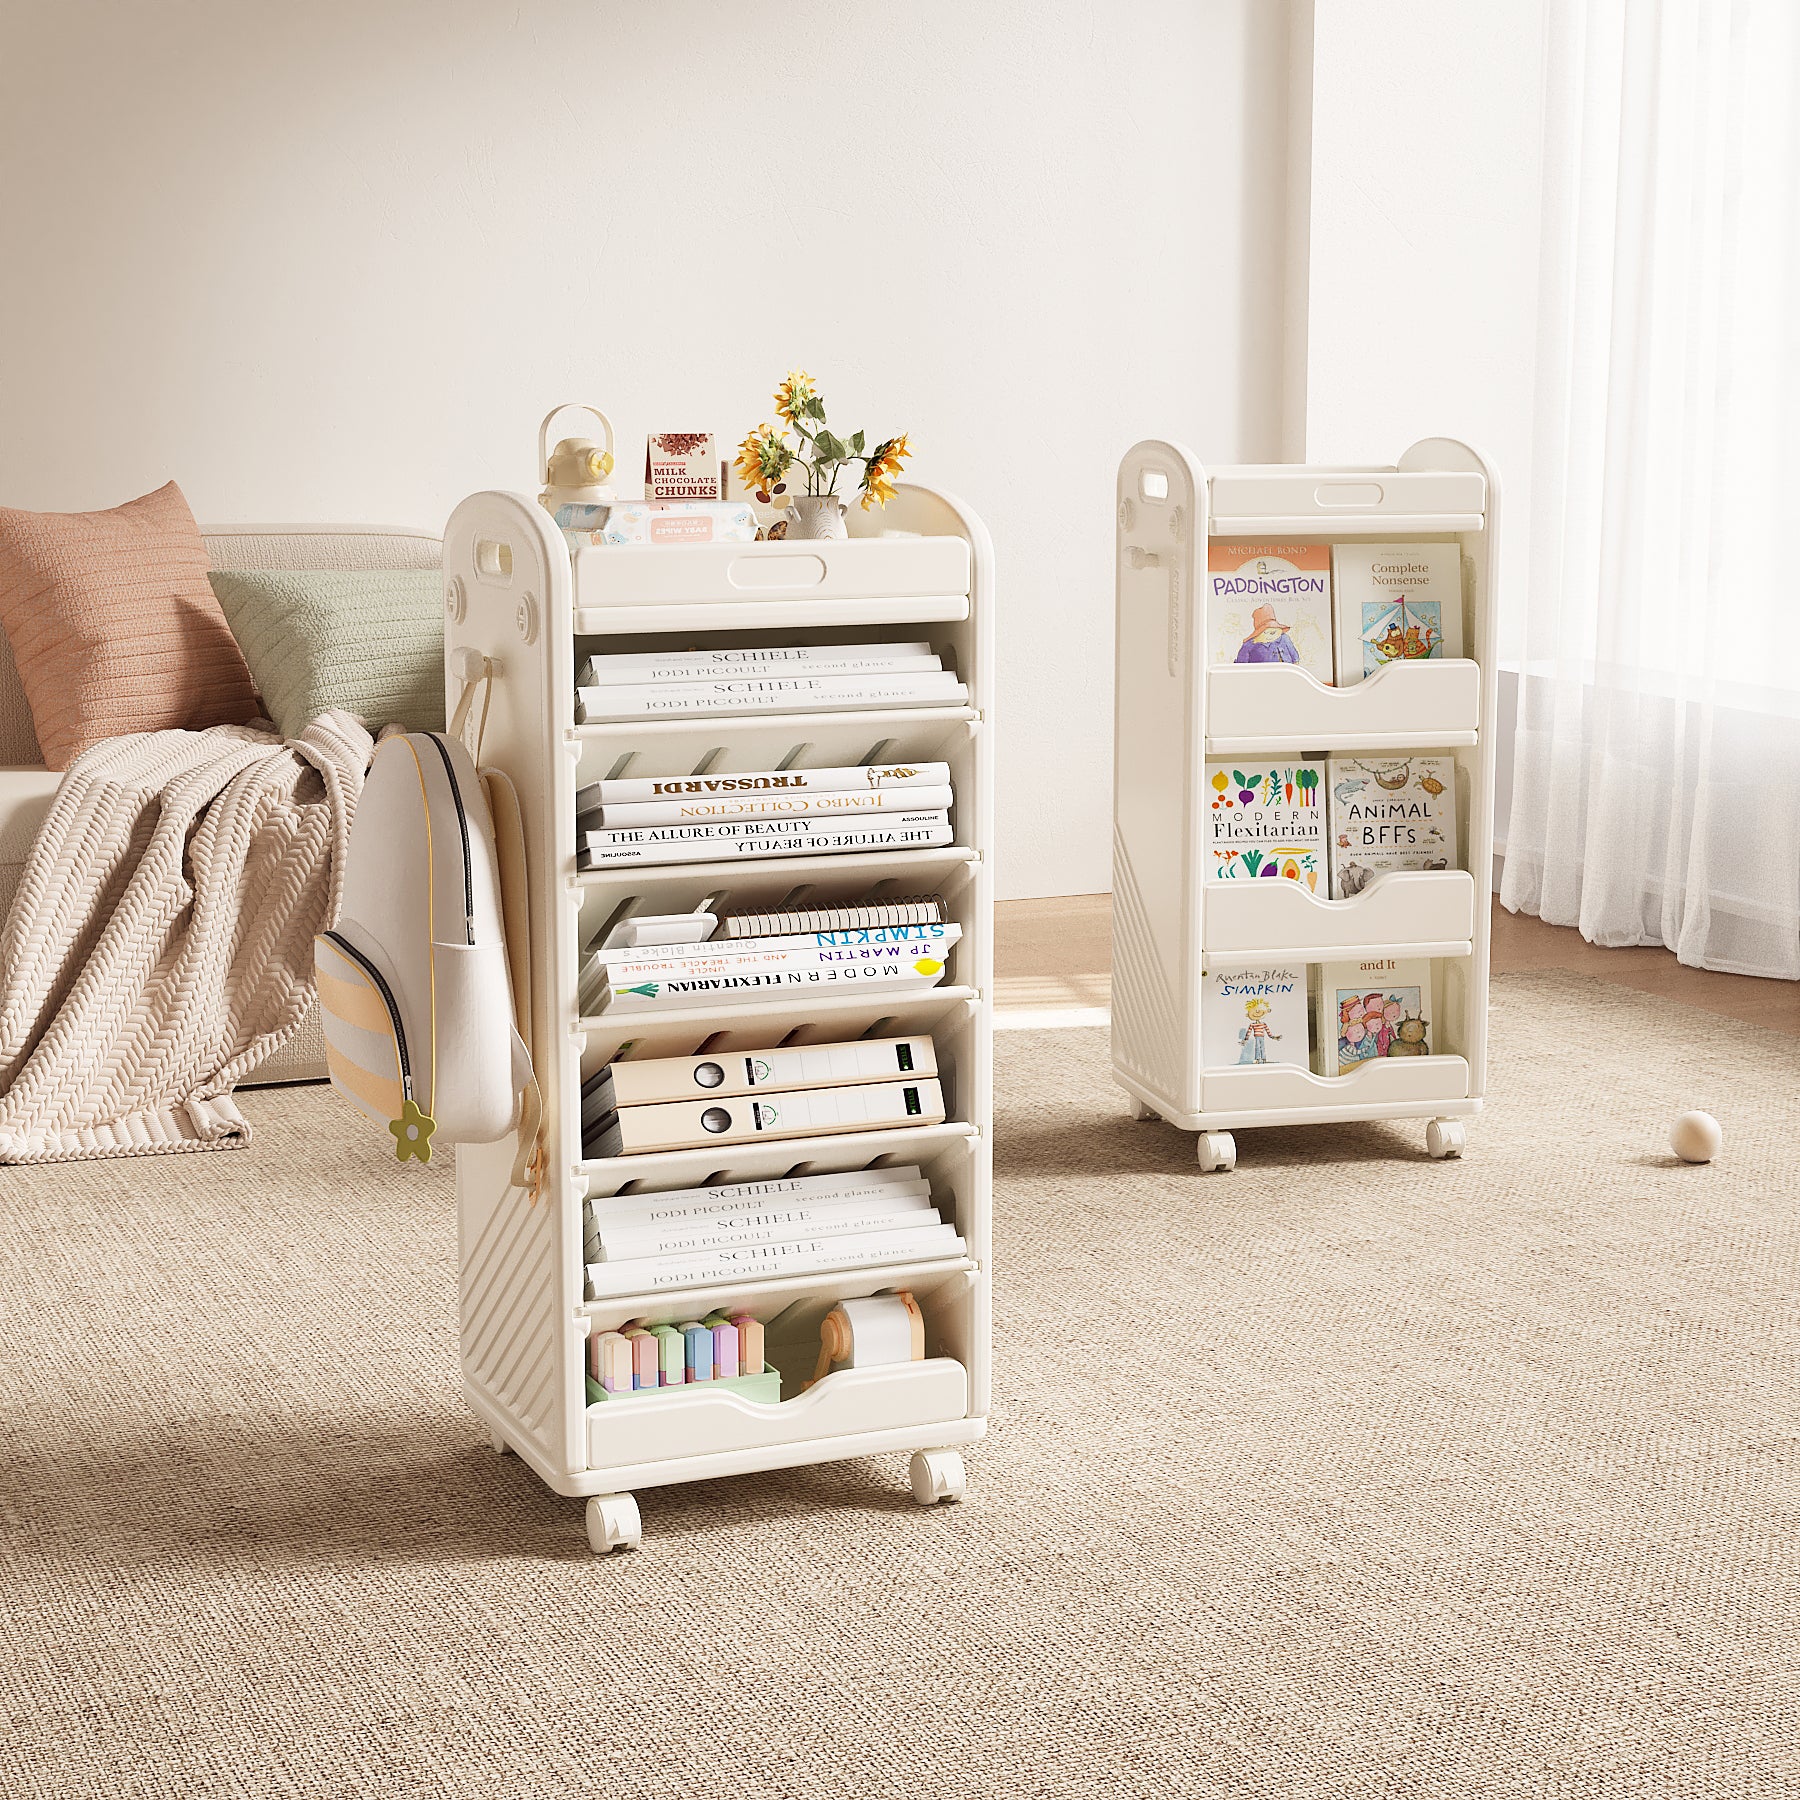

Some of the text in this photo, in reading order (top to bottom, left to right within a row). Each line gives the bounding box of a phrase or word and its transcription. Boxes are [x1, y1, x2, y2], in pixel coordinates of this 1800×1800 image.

[654, 468, 687, 476] MILK
[655, 486, 717, 496] CHUNKS
[1228, 546, 1307, 556] MICHAEL BOND
[1371, 563, 1429, 575] Complete
[1371, 575, 1430, 586] Nonsense
[712, 650, 809, 663] SCHIELE
[652, 660, 894, 678] JODI PICOULT second glance
[714, 679, 822, 693] SCHIELE
[646, 690, 916, 710] JODI PICOULT second glance
[653, 775, 808, 795] TRUSSARDI
[680, 792, 884, 817] JUMBO COLLECTION
[1212, 810, 1319, 822] MODERN
[608, 831, 644, 843] THE
[649, 827, 715, 841] ALLURE
[718, 825, 741, 836] OF
[745, 821, 811, 834] BEAUTY
[1214, 821, 1318, 837] Flexitarian
[816, 924, 944, 946] SIMPKIN
[693, 940, 757, 951] Quentin
[820, 944, 931, 962] JP MARTIN
[622, 962, 675, 973] TROUBLE
[680, 958, 729, 967] TREACLE
[736, 956, 757, 964] THE
[1360, 960, 1396, 970] and It
[668, 965, 898, 993] MODERN FLEXITARIAN
[1258, 969, 1298, 983] Blake
[1221, 984, 1294, 996] SIMPKIN
[708, 1181, 802, 1200] SCHIELE
[650, 1188, 885, 1221] JODI PICOULT second glance
[717, 1210, 811, 1230] SCHIELE
[658, 1218, 895, 1251] JODI PICOULT second glance
[719, 1242, 824, 1262] SCHIELE
[653, 1247, 916, 1285] JODI PICOULT second glance
